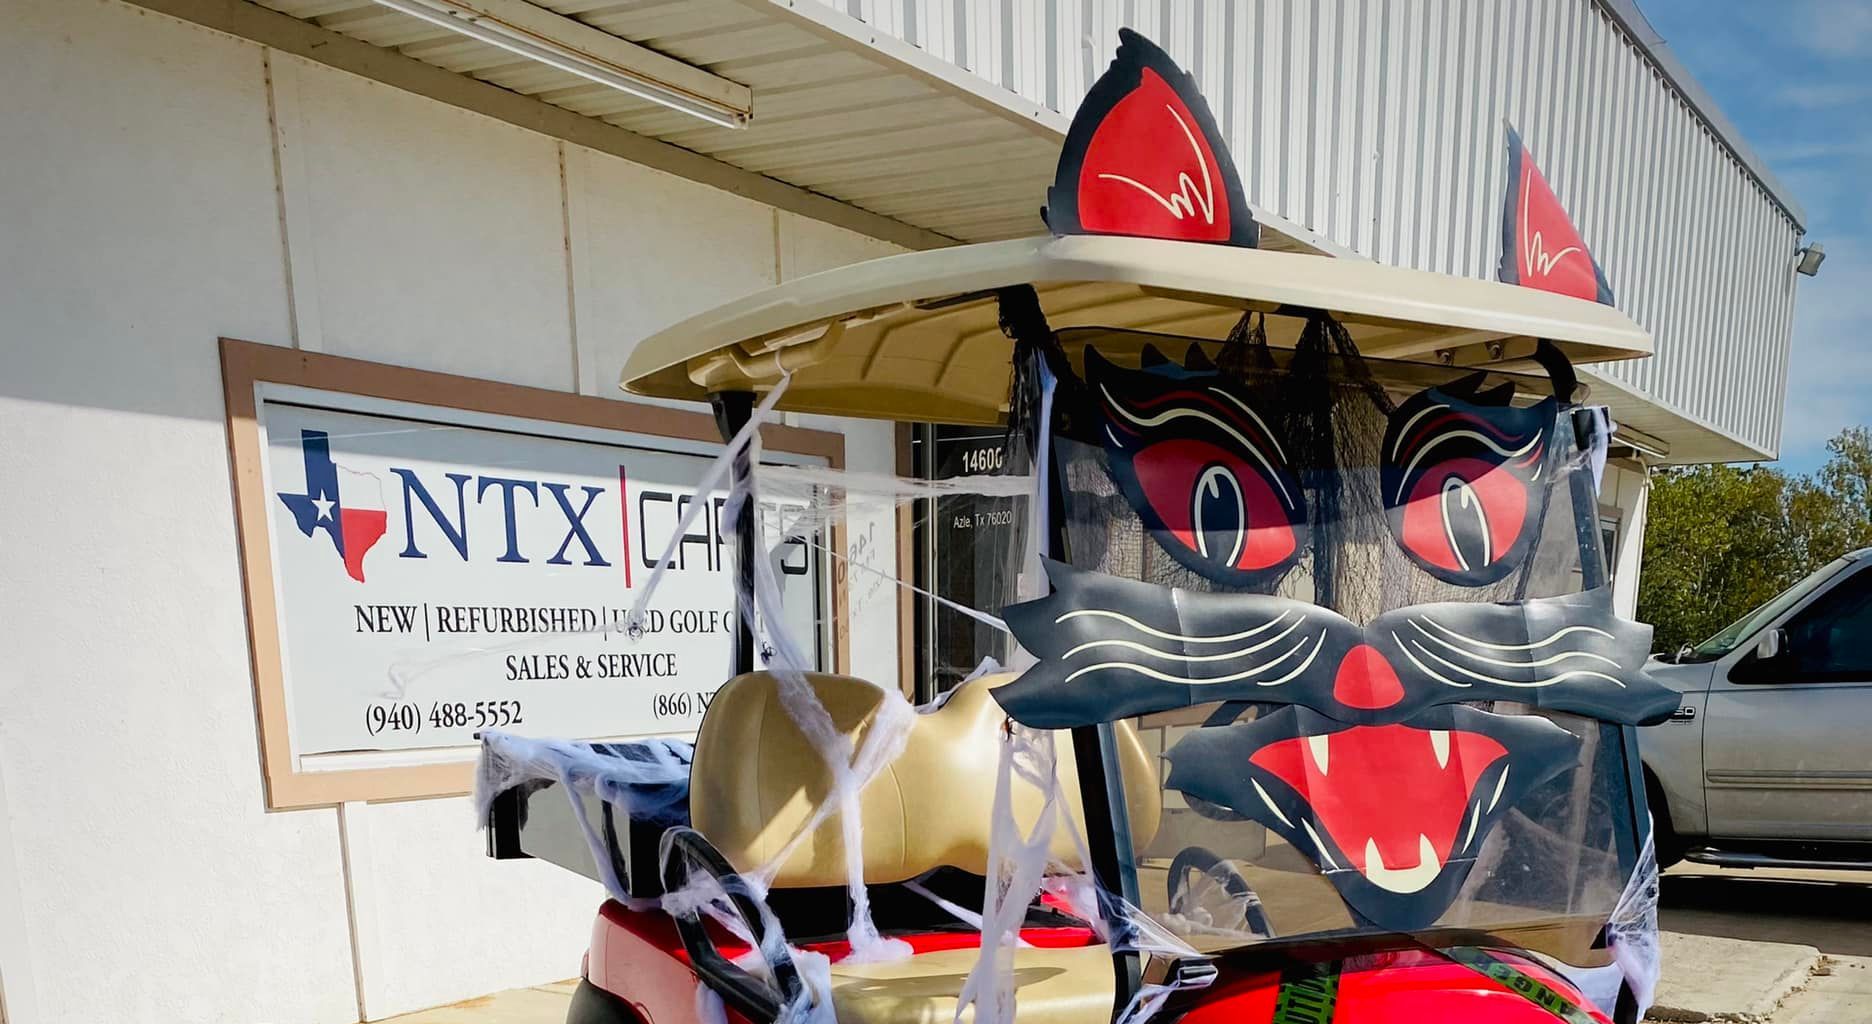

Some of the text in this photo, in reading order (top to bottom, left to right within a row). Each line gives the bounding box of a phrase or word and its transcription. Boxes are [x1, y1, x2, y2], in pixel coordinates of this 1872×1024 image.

[390, 467, 809, 575] NTX CAS
[986, 510, 1012, 526] 76020
[354, 605, 418, 633] NEW
[436, 606, 596, 634] REFURBISHED
[612, 608, 664, 634] UED
[670, 609, 719, 634] GOLF
[506, 653, 677, 681] SALES & SERVICE
[366, 701, 523, 736] (940) 488-5552
[653, 692, 692, 720] (866)
